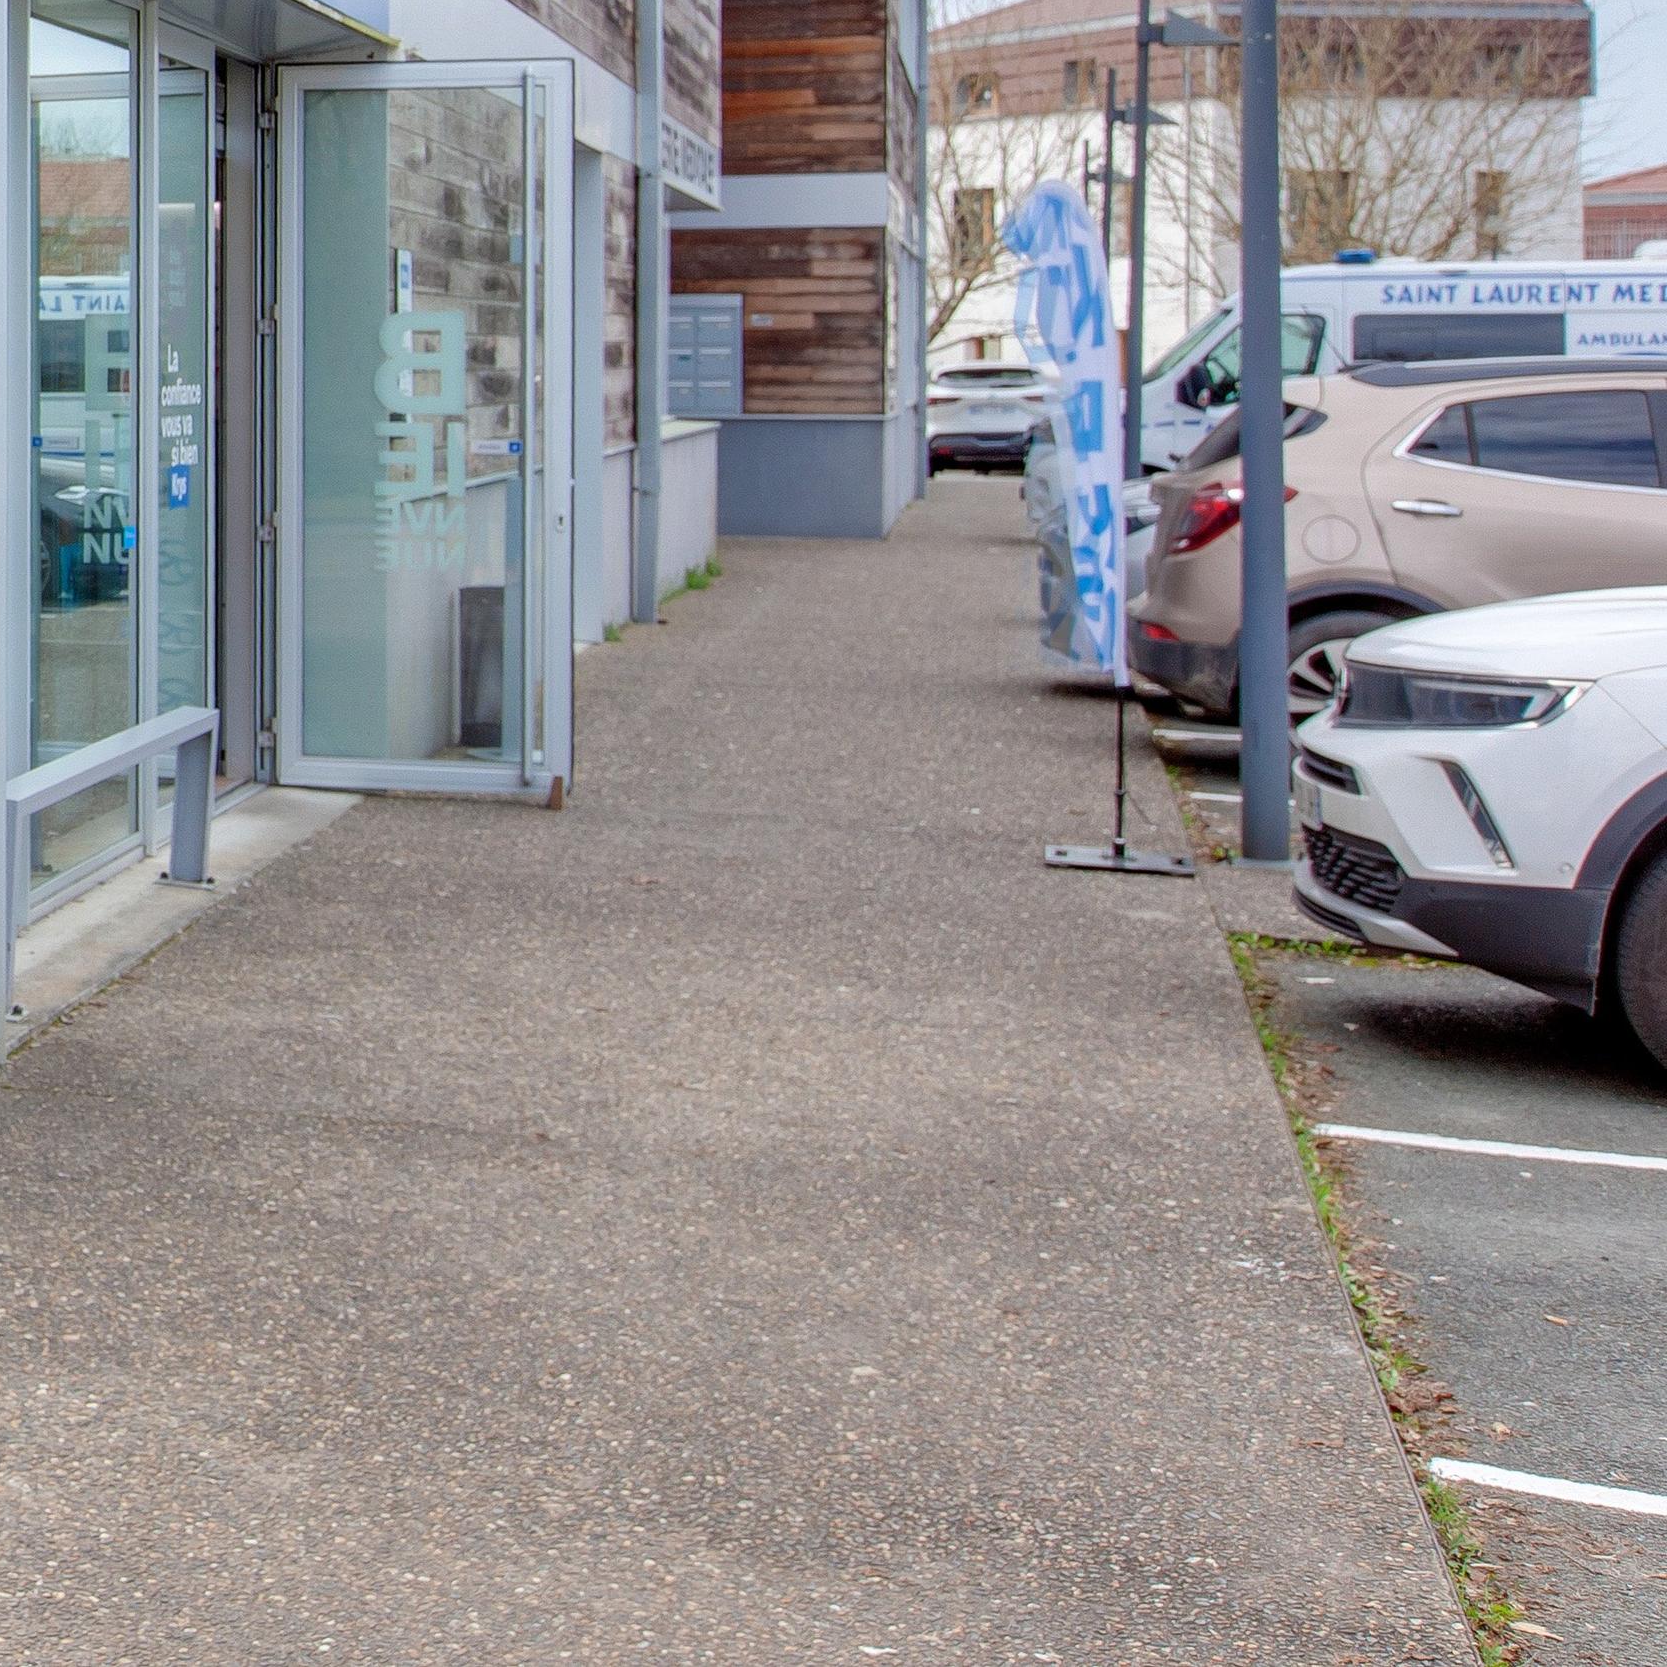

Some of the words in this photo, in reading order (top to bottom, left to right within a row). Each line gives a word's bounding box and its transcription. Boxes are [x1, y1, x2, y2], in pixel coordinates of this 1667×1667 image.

[1381, 283, 1458, 304] SAINT
[1470, 283, 1601, 304] LAURENT
[168, 343, 179, 373] La
[161, 377, 201, 407] confiance
[161, 415, 182, 438] vous
[182, 413, 193, 436] va
[171, 439, 179, 467] si
[179, 437, 199, 466] bien
[171, 473, 188, 502] Krys
